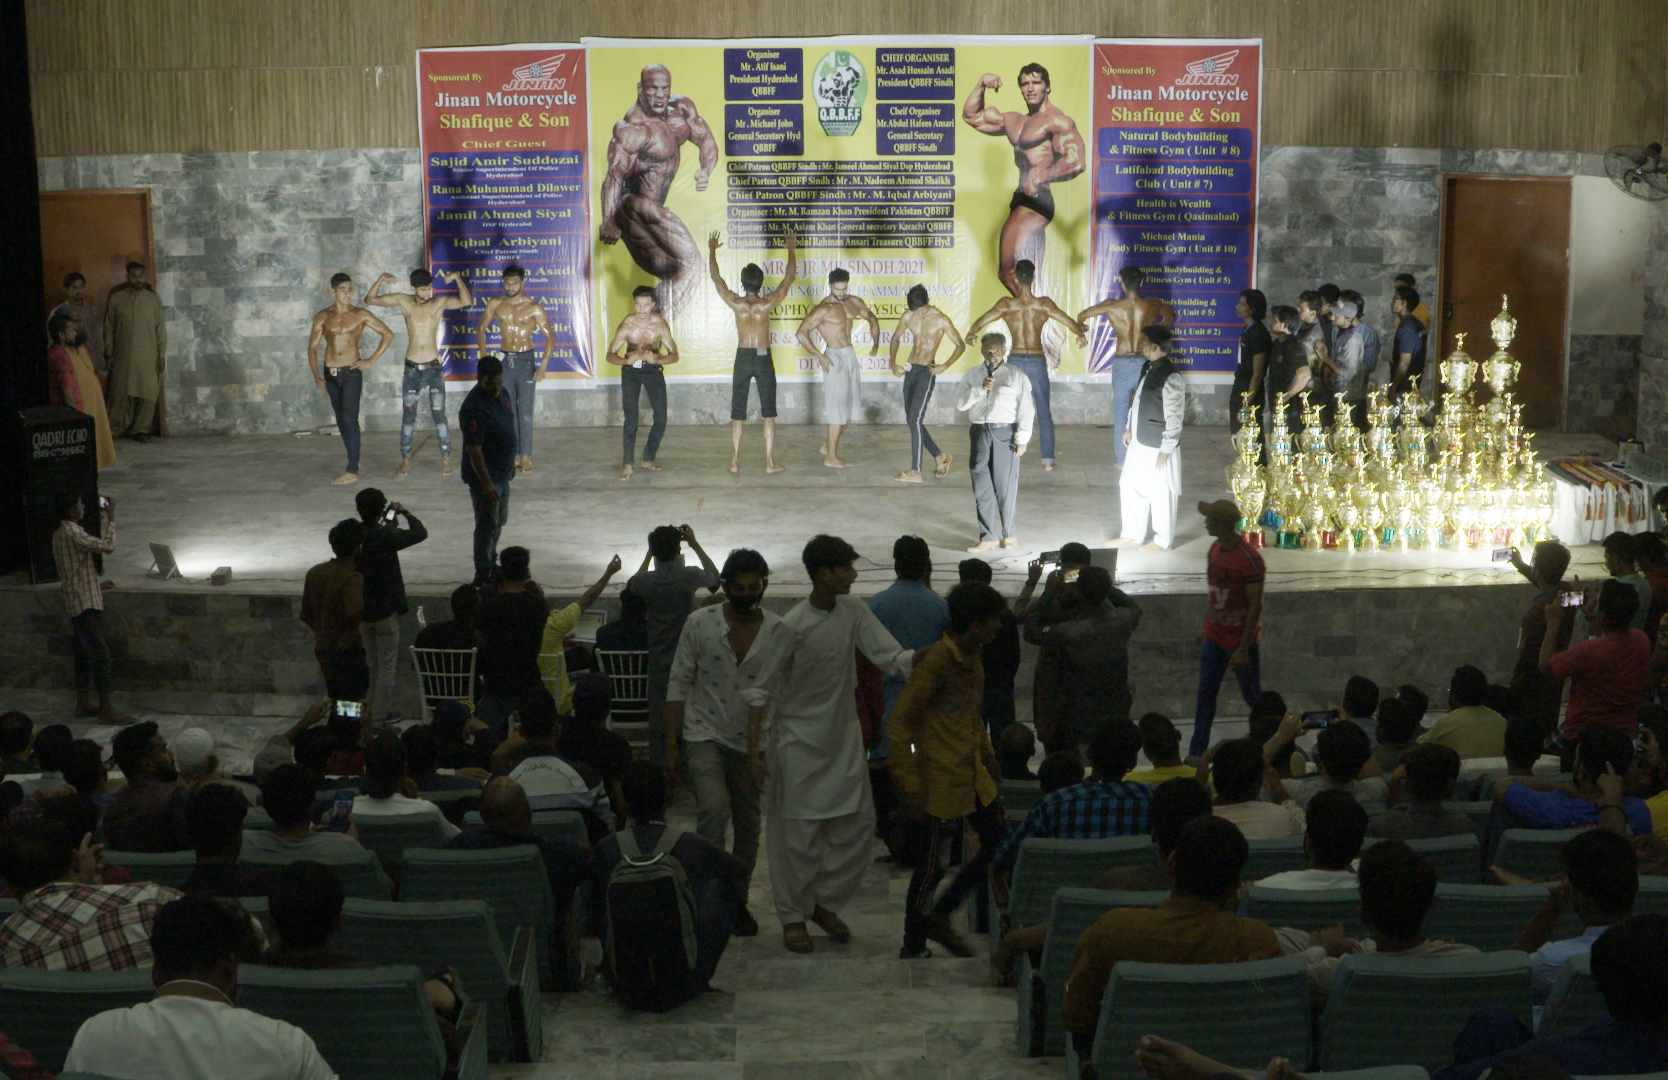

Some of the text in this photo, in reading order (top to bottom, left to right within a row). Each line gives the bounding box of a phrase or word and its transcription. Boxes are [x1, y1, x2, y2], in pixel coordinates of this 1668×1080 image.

[747, 51, 779, 60] Organiser
[882, 54, 949, 62] CHEIF ORGANISER
[755, 62, 769, 71] Atif
[771, 63, 786, 71] Isani
[876, 66, 954, 74] Mr. Asad Hussain Asadi
[1102, 67, 1156, 75] Sponsored By
[428, 74, 469, 82] Sponsored
[730, 74, 797, 83] President Hyderabad
[878, 78, 953, 88] President QBBFF Sindh
[1176, 74, 1238, 85] JINAN
[502, 78, 566, 90] JINAN
[752, 87, 776, 97] QBBFF
[1108, 86, 1248, 104] Jinan Motorcycle
[435, 91, 577, 109] Jinan Motorcycle
[748, 107, 780, 117] Organiser
[820, 109, 860, 121] Q.B.B.F.F
[890, 107, 941, 117] Cheif Organiser
[1112, 108, 1240, 126] Shafique & Son
[440, 114, 570, 131] Shafique & Son
[750, 120, 776, 128] Michael
[777, 120, 793, 129] John
[933, 119, 954, 127] Ansari
[729, 132, 801, 141] General Secretary Hyd
[887, 132, 943, 142] General Secretary
[1120, 131, 1228, 143] Natural Bodybuilding
[753, 144, 777, 153] QBBFF
[894, 144, 937, 153] QBBFF Sindh
[1110, 146, 1119, 154] &
[1123, 146, 1157, 154] Fitness
[431, 157, 467, 169] Sajid
[472, 157, 509, 165] Amir
[1116, 165, 1234, 176] Latifabad Bodybuilding
[433, 185, 461, 194] Rana
[466, 184, 533, 193] Muhammad
[1137, 200, 1166, 208] Health
[1180, 200, 1211, 208] Wealth
[437, 211, 477, 220] Jamil
[481, 209, 532, 219] Ahmed
[1119, 212, 1150, 220] Fitness
[1141, 232, 1175, 240] Michael
[499, 237, 562, 248] Arbiyani
[1109, 244, 1130, 254] Body
[1134, 244, 1163, 252] Fitness
[763, 261, 926, 278] MR JR SINDH 2021
[1165, 266, 1213, 276] Bodybuilding
